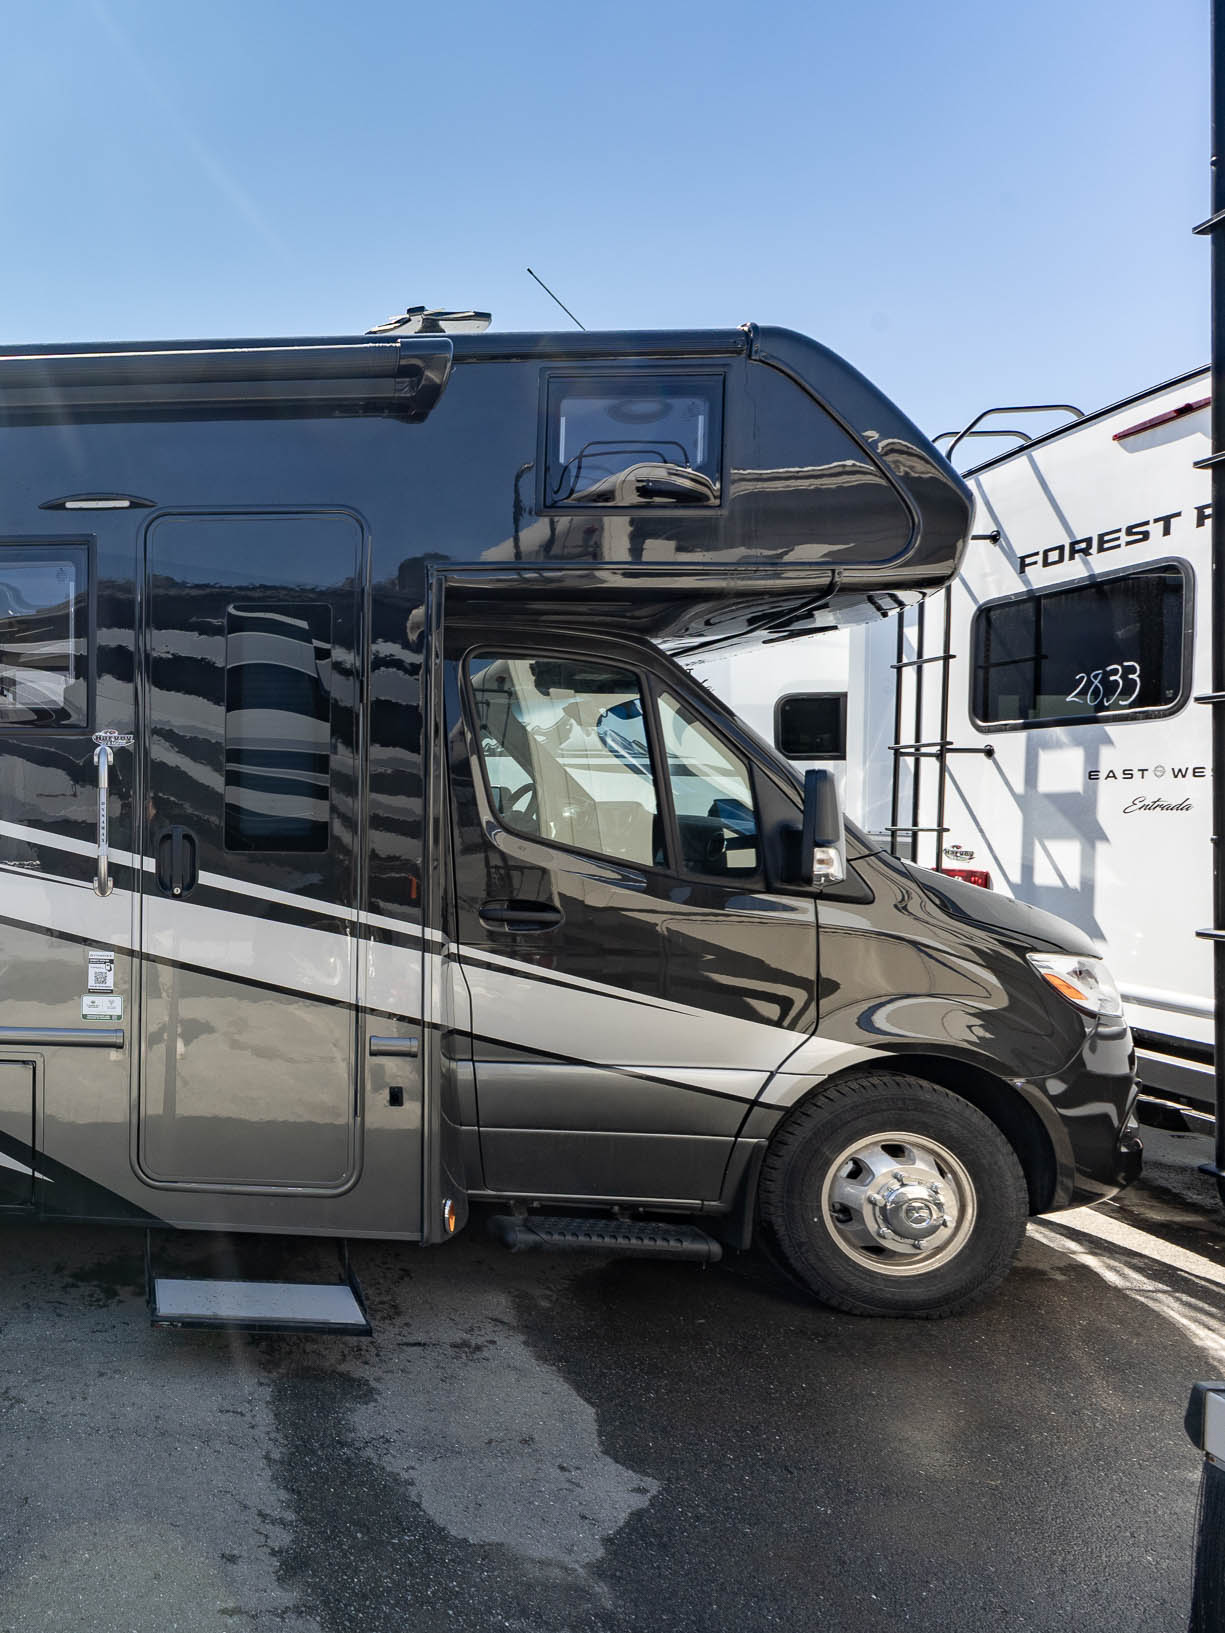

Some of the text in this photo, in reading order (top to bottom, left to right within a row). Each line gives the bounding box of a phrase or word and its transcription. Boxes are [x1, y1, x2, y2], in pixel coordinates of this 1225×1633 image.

[1017, 510, 1183, 575] FOREST
[1065, 661, 1141, 706] 2833
[1087, 766, 1214, 781] EAST WE
[1122, 796, 1194, 814] Entrada
